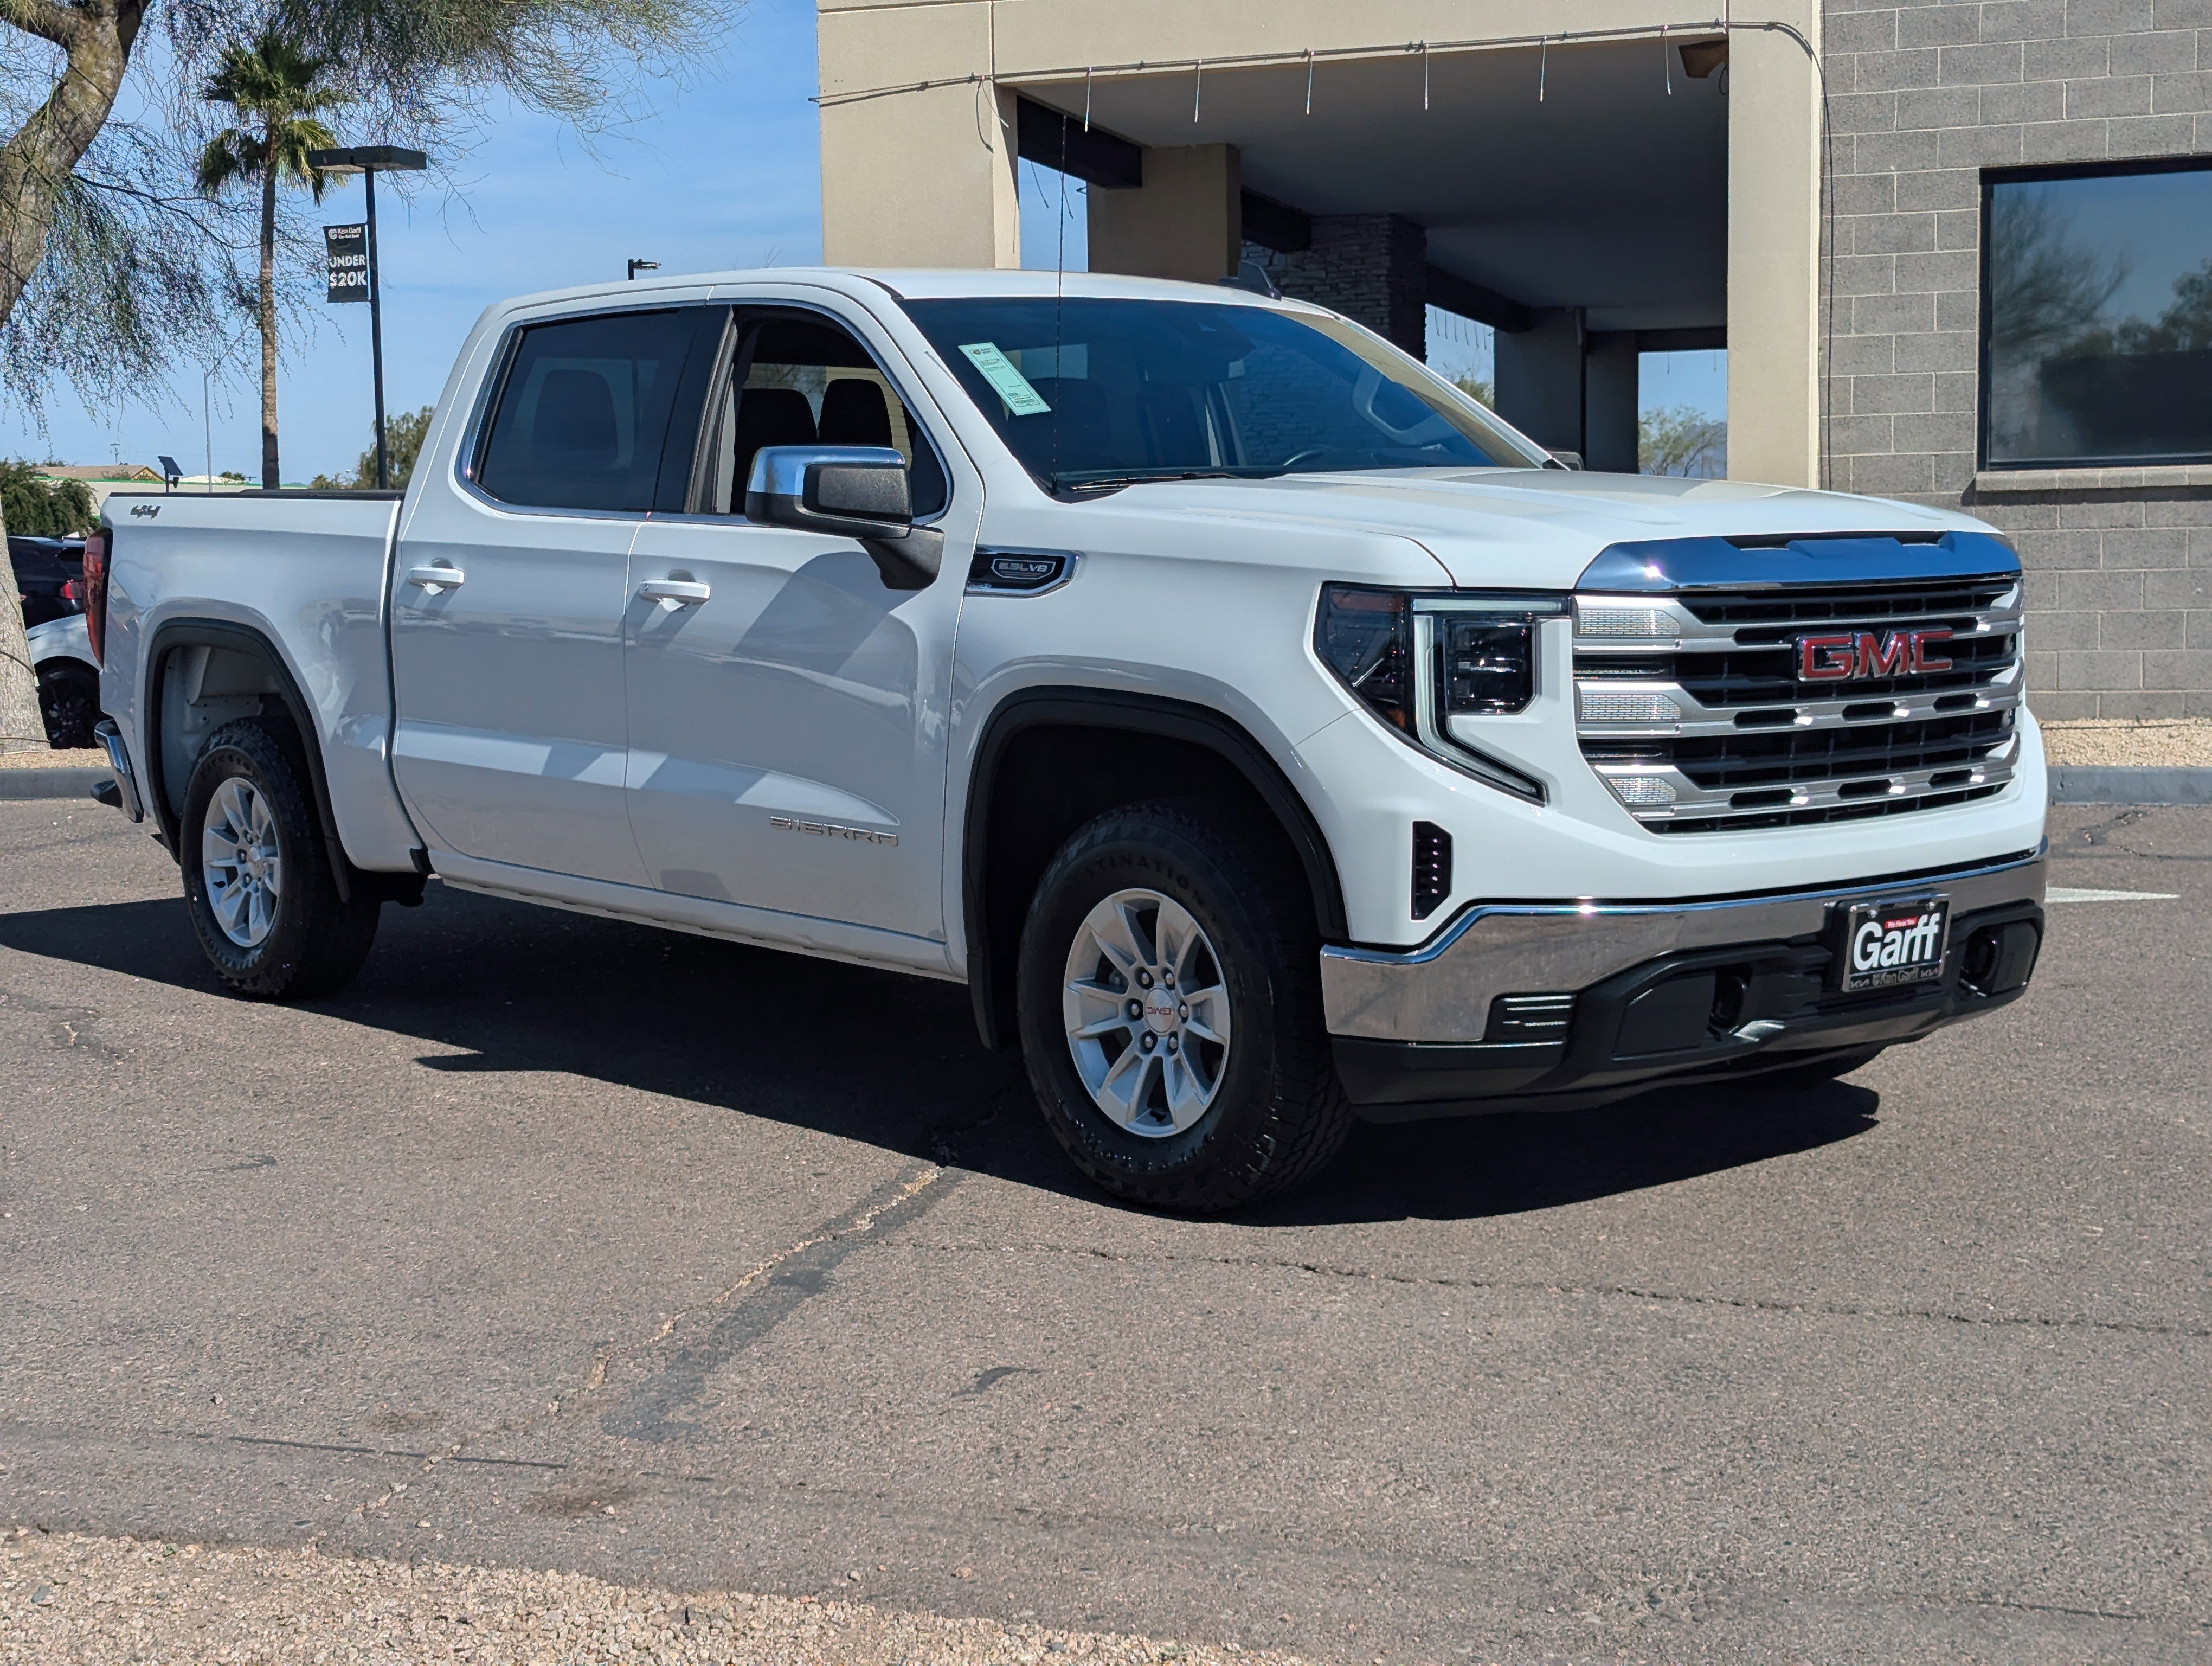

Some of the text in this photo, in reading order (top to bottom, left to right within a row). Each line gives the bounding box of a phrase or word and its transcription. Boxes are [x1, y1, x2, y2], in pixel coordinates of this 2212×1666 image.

[329, 254, 366, 268] UNDER
[329, 271, 368, 289] $20K
[1029, 564, 1047, 572] V8
[1798, 629, 1953, 682] GMC
[770, 816, 899, 847] SIERRA
[1853, 912, 1941, 971] Garff
[1880, 971, 1898, 985] Ken
[1898, 967, 1919, 982] Garff
[1146, 1007, 1172, 1015] GMC
